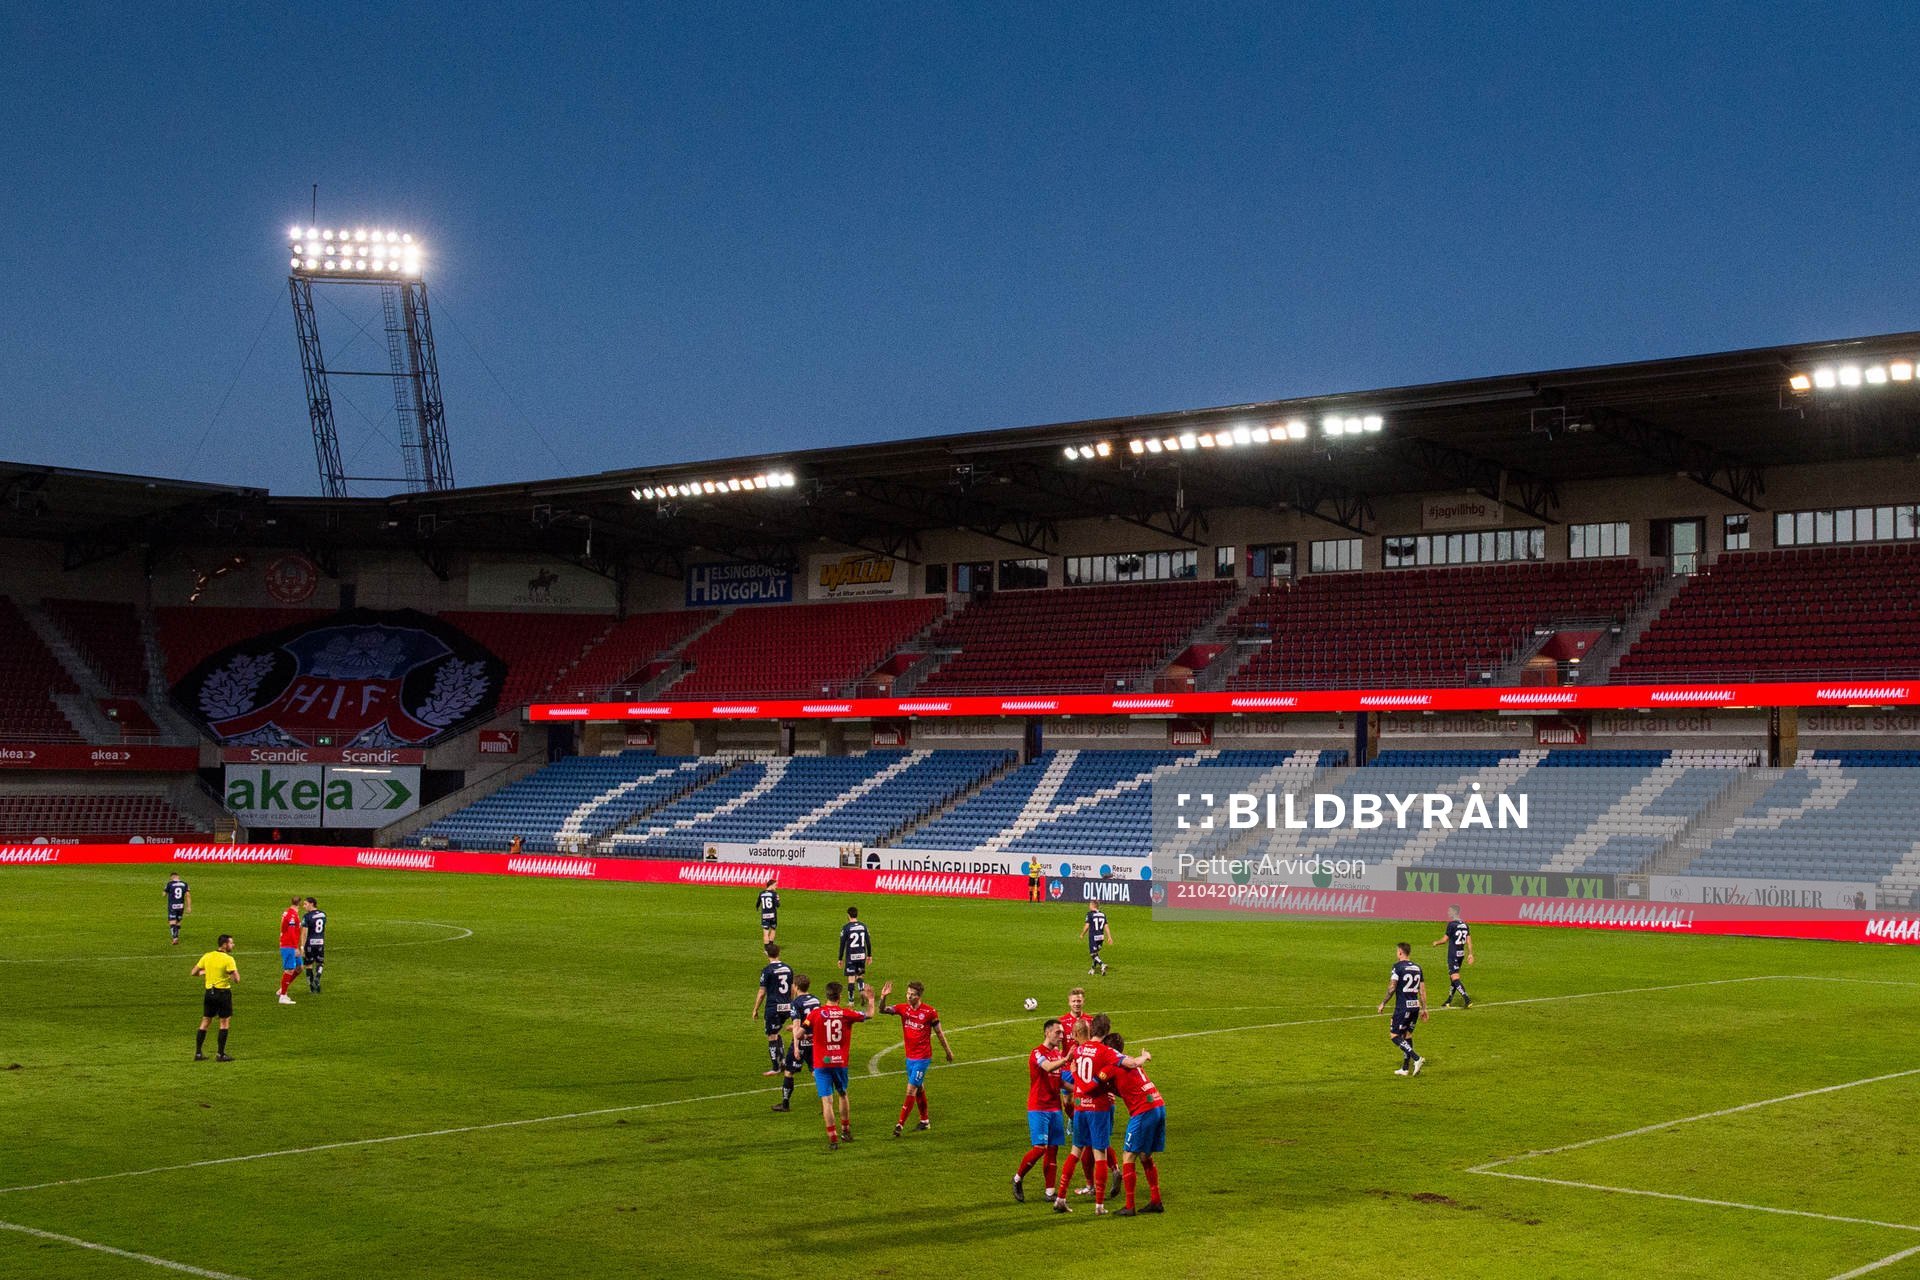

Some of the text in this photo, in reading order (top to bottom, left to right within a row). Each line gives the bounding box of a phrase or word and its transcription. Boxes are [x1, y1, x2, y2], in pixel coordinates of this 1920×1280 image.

[1429, 503, 1485, 520] #jagvillhbg
[711, 577, 787, 601] BYGGPLÅT
[1173, 731, 1202, 744] PUMA
[1539, 729, 1575, 744] PUMA
[480, 741, 510, 752] PUMA
[91, 749, 119, 760] akea
[250, 748, 308, 762] Scandic
[342, 750, 400, 763] Scandic
[227, 769, 353, 811] akea
[749, 847, 806, 860] vasatorp.golf
[1072, 863, 1092, 871] Resurs
[1112, 864, 1132, 873] Resurs
[174, 887, 183, 899] 9
[1083, 881, 1130, 902] OLYMPIA
[1754, 885, 1823, 908] MÖBLER
[761, 897, 773, 909] 16
[315, 918, 324, 934] 8
[1093, 917, 1105, 931] 17
[850, 931, 865, 948] 21
[1455, 930, 1468, 945] 23
[778, 974, 789, 994] 3
[1402, 973, 1421, 993] 22
[823, 1019, 843, 1043] 13
[1075, 1056, 1093, 1084] 10
